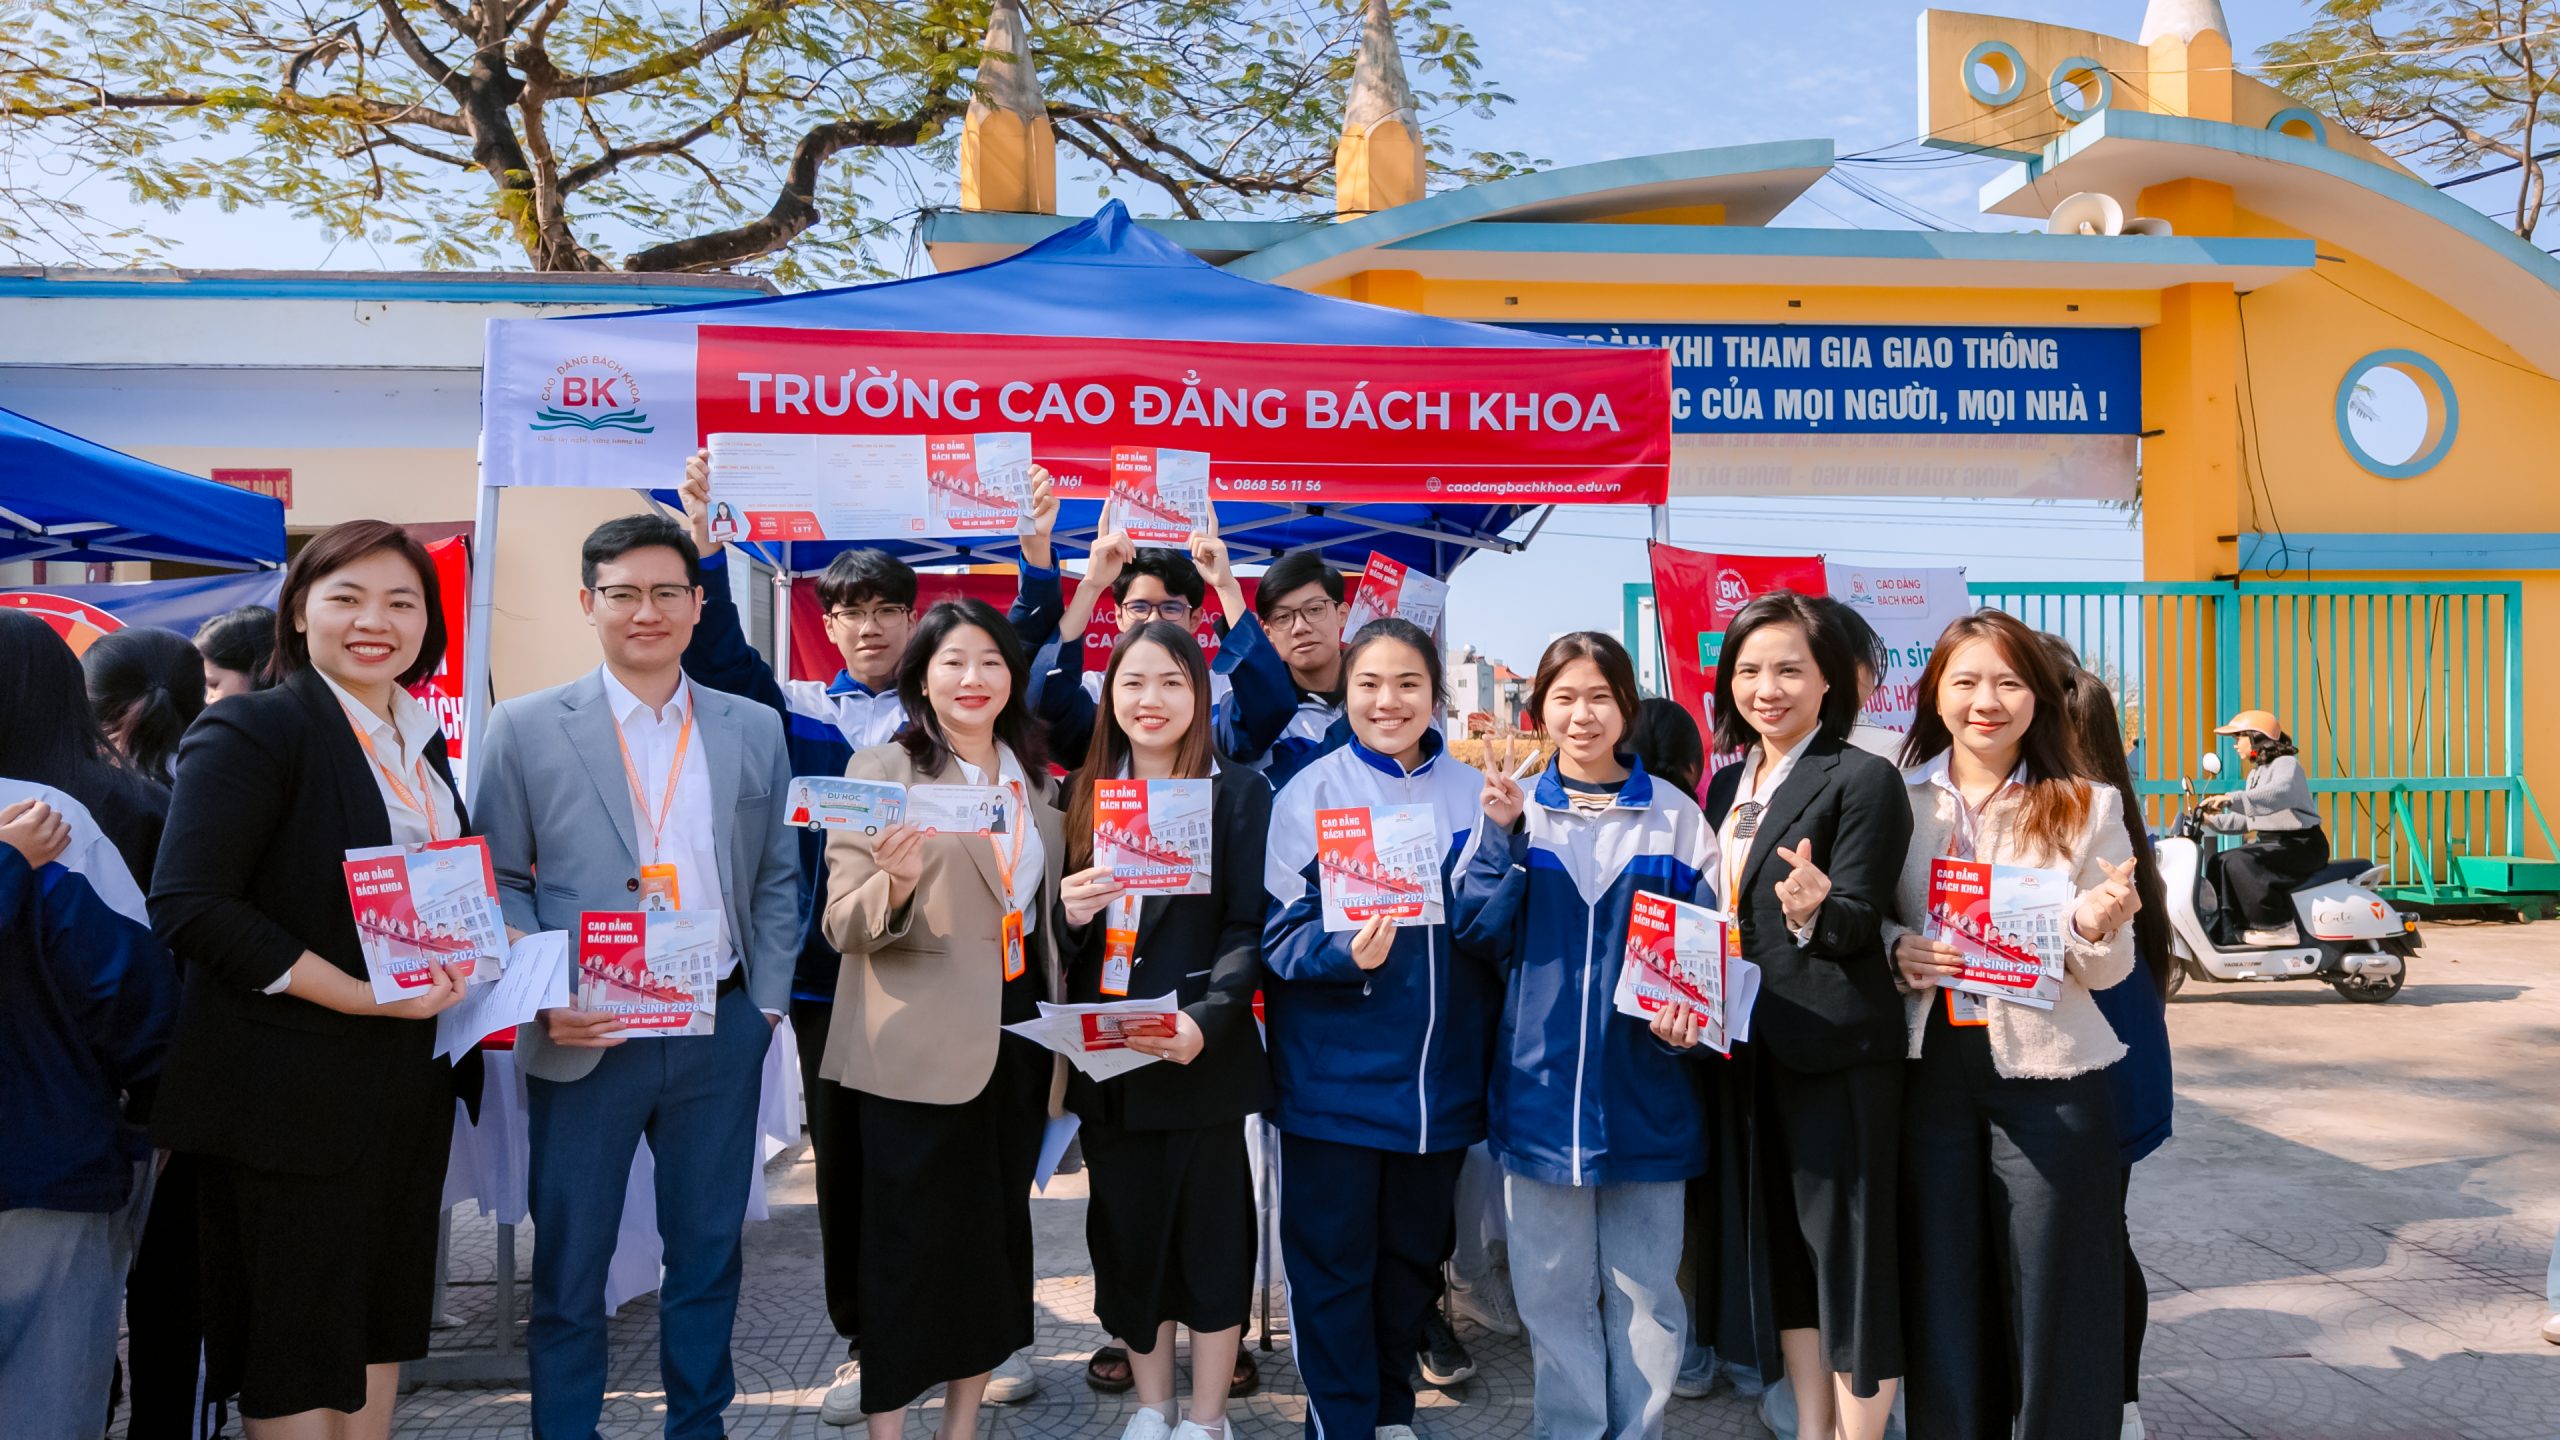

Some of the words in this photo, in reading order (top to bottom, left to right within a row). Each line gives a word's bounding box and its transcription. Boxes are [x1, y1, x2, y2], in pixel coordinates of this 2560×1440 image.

[1660, 336, 1713, 367] KHI
[1723, 336, 1810, 368] THAM
[1821, 337, 1872, 368] GIA
[1883, 337, 1953, 368] GIAO
[1963, 331, 2058, 369] THÔNG
[562, 376, 619, 408] BK
[738, 366, 980, 421] TRƯỜNG
[999, 381, 1115, 424] CAO
[1130, 369, 1287, 428] ĐẲNG
[1306, 381, 1450, 430] BÁCH
[1470, 392, 1620, 432] KHOA
[1702, 376, 1763, 419] CỦA
[1774, 389, 1833, 427] MỌI
[1845, 381, 1948, 425] NGƯỜI,
[1958, 389, 2015, 426] MỌI
[2026, 383, 2088, 421] NHÀ
[2099, 391, 2107, 421] !
[931, 443, 945, 451] CAO
[1059, 475, 1083, 490] Nội
[1233, 479, 1268, 491] 0868
[1270, 480, 1287, 491] 56
[1291, 481, 1302, 491] 11
[1305, 480, 1322, 492] 56
[1447, 479, 1622, 494] caodangbachkhoa.edu.vn
[1720, 581, 1743, 599] BK
[1876, 579, 1894, 590] CAO
[1901, 596, 1925, 605] KHOA
[1100, 788, 1115, 798] CAO
[1117, 785, 1137, 798] ĐẲNG
[1100, 800, 1120, 810] BÁCH
[1121, 801, 1142, 810] KHOA
[1322, 818, 1339, 828] CAO
[1339, 814, 1360, 826] ĐẲNG
[1323, 830, 1344, 840] BÁCH
[1345, 828, 1367, 838] KHOA
[352, 871, 370, 883] CAO
[371, 865, 395, 881] ĐẲNG
[1113, 866, 1144, 877] UYỂN
[1145, 866, 1171, 875] SINH
[1173, 865, 1198, 874] 2026
[1937, 869, 1954, 880] CAO
[1956, 867, 1979, 882] ĐẲNG
[356, 883, 379, 897] BÁCH
[380, 881, 403, 893] KHOA
[1936, 881, 1959, 892] BÁCH
[1960, 883, 1984, 895] KHOA
[1376, 894, 1401, 905] SINH
[1404, 893, 1430, 903] 2026
[1634, 902, 1647, 914] CAO
[588, 922, 607, 931] CAO
[608, 918, 633, 931] ĐẲNG
[588, 934, 612, 944] BÁCH
[614, 935, 638, 944] KHOA
[453, 948, 482, 964] 2026
[1983, 957, 2013, 971] SINH
[2017, 961, 2047, 976] 2026
[638, 1003, 669, 1014] SINH
[671, 1002, 700, 1013] 2026
